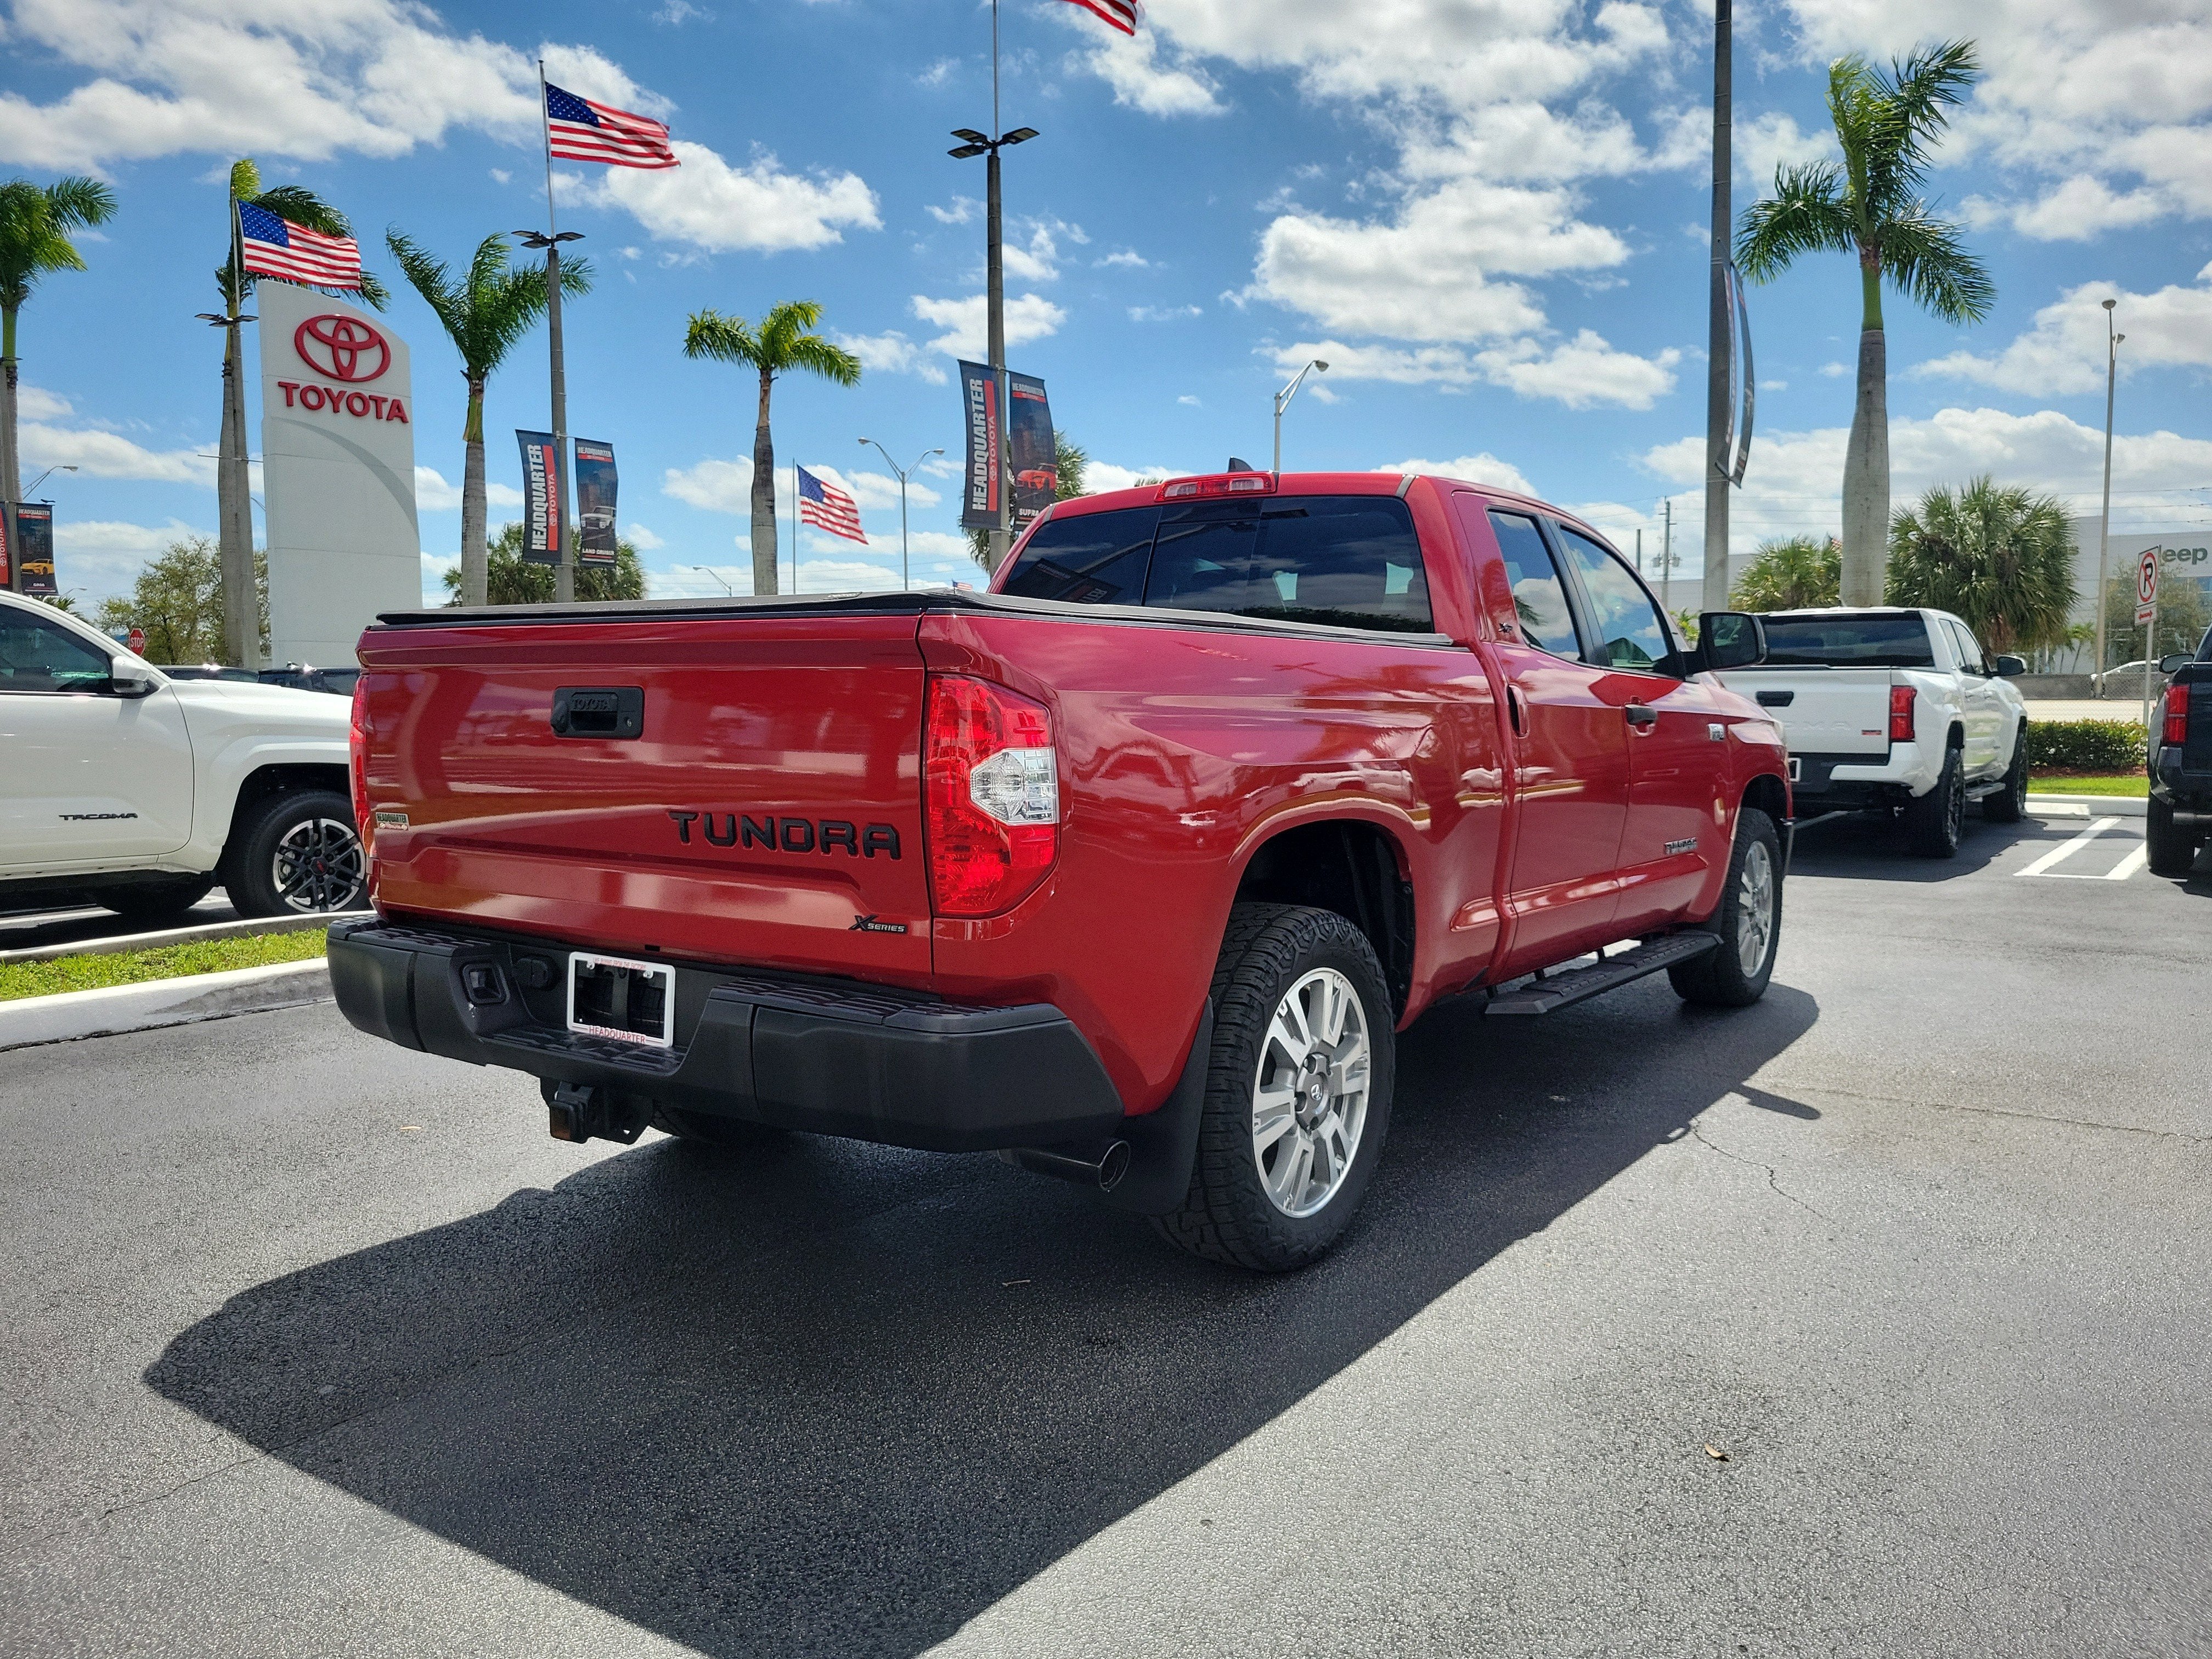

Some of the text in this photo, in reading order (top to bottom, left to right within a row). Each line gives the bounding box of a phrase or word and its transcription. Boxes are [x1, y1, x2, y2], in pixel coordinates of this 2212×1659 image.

[278, 381, 409, 424] TOYOTA
[970, 378, 987, 511] HEADQUARTER
[988, 416, 997, 465] TOYOTA
[527, 444, 548, 550] HEADQUARTER
[548, 474, 557, 515] TOYOTA
[1019, 508, 1040, 517] SUPRA
[2159, 548, 2208, 565] eep
[131, 637, 144, 647] STOP
[572, 698, 612, 710] TOYOTA
[59, 812, 138, 821] TACOMA
[668, 810, 901, 861] TUNDRA
[589, 1025, 646, 1043] HEADQUARTER
